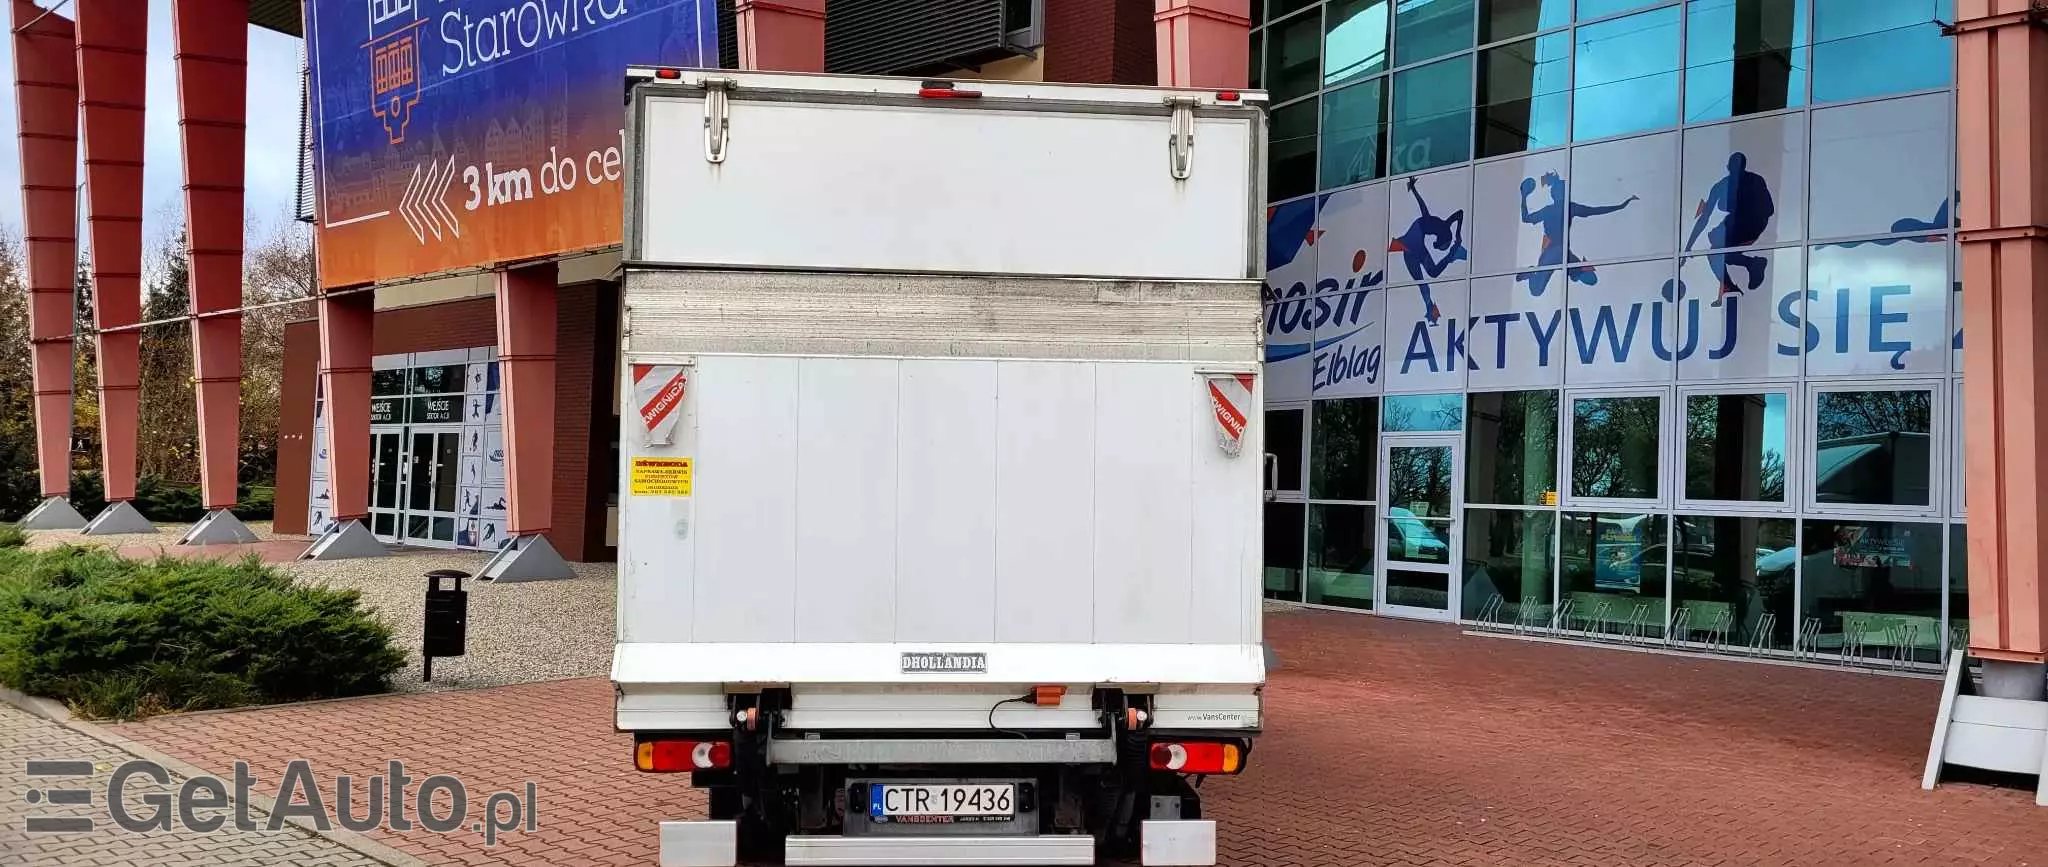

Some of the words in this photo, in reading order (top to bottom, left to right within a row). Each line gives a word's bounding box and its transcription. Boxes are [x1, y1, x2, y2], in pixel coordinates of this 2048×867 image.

[463, 165, 482, 211] 3
[485, 161, 534, 206] km
[540, 146, 577, 195] do
[1777, 284, 1912, 370] SIĘ
[902, 656, 985, 669] DHOLLANDIA
[885, 788, 930, 812] CTR
[940, 788, 1010, 812] 19436
